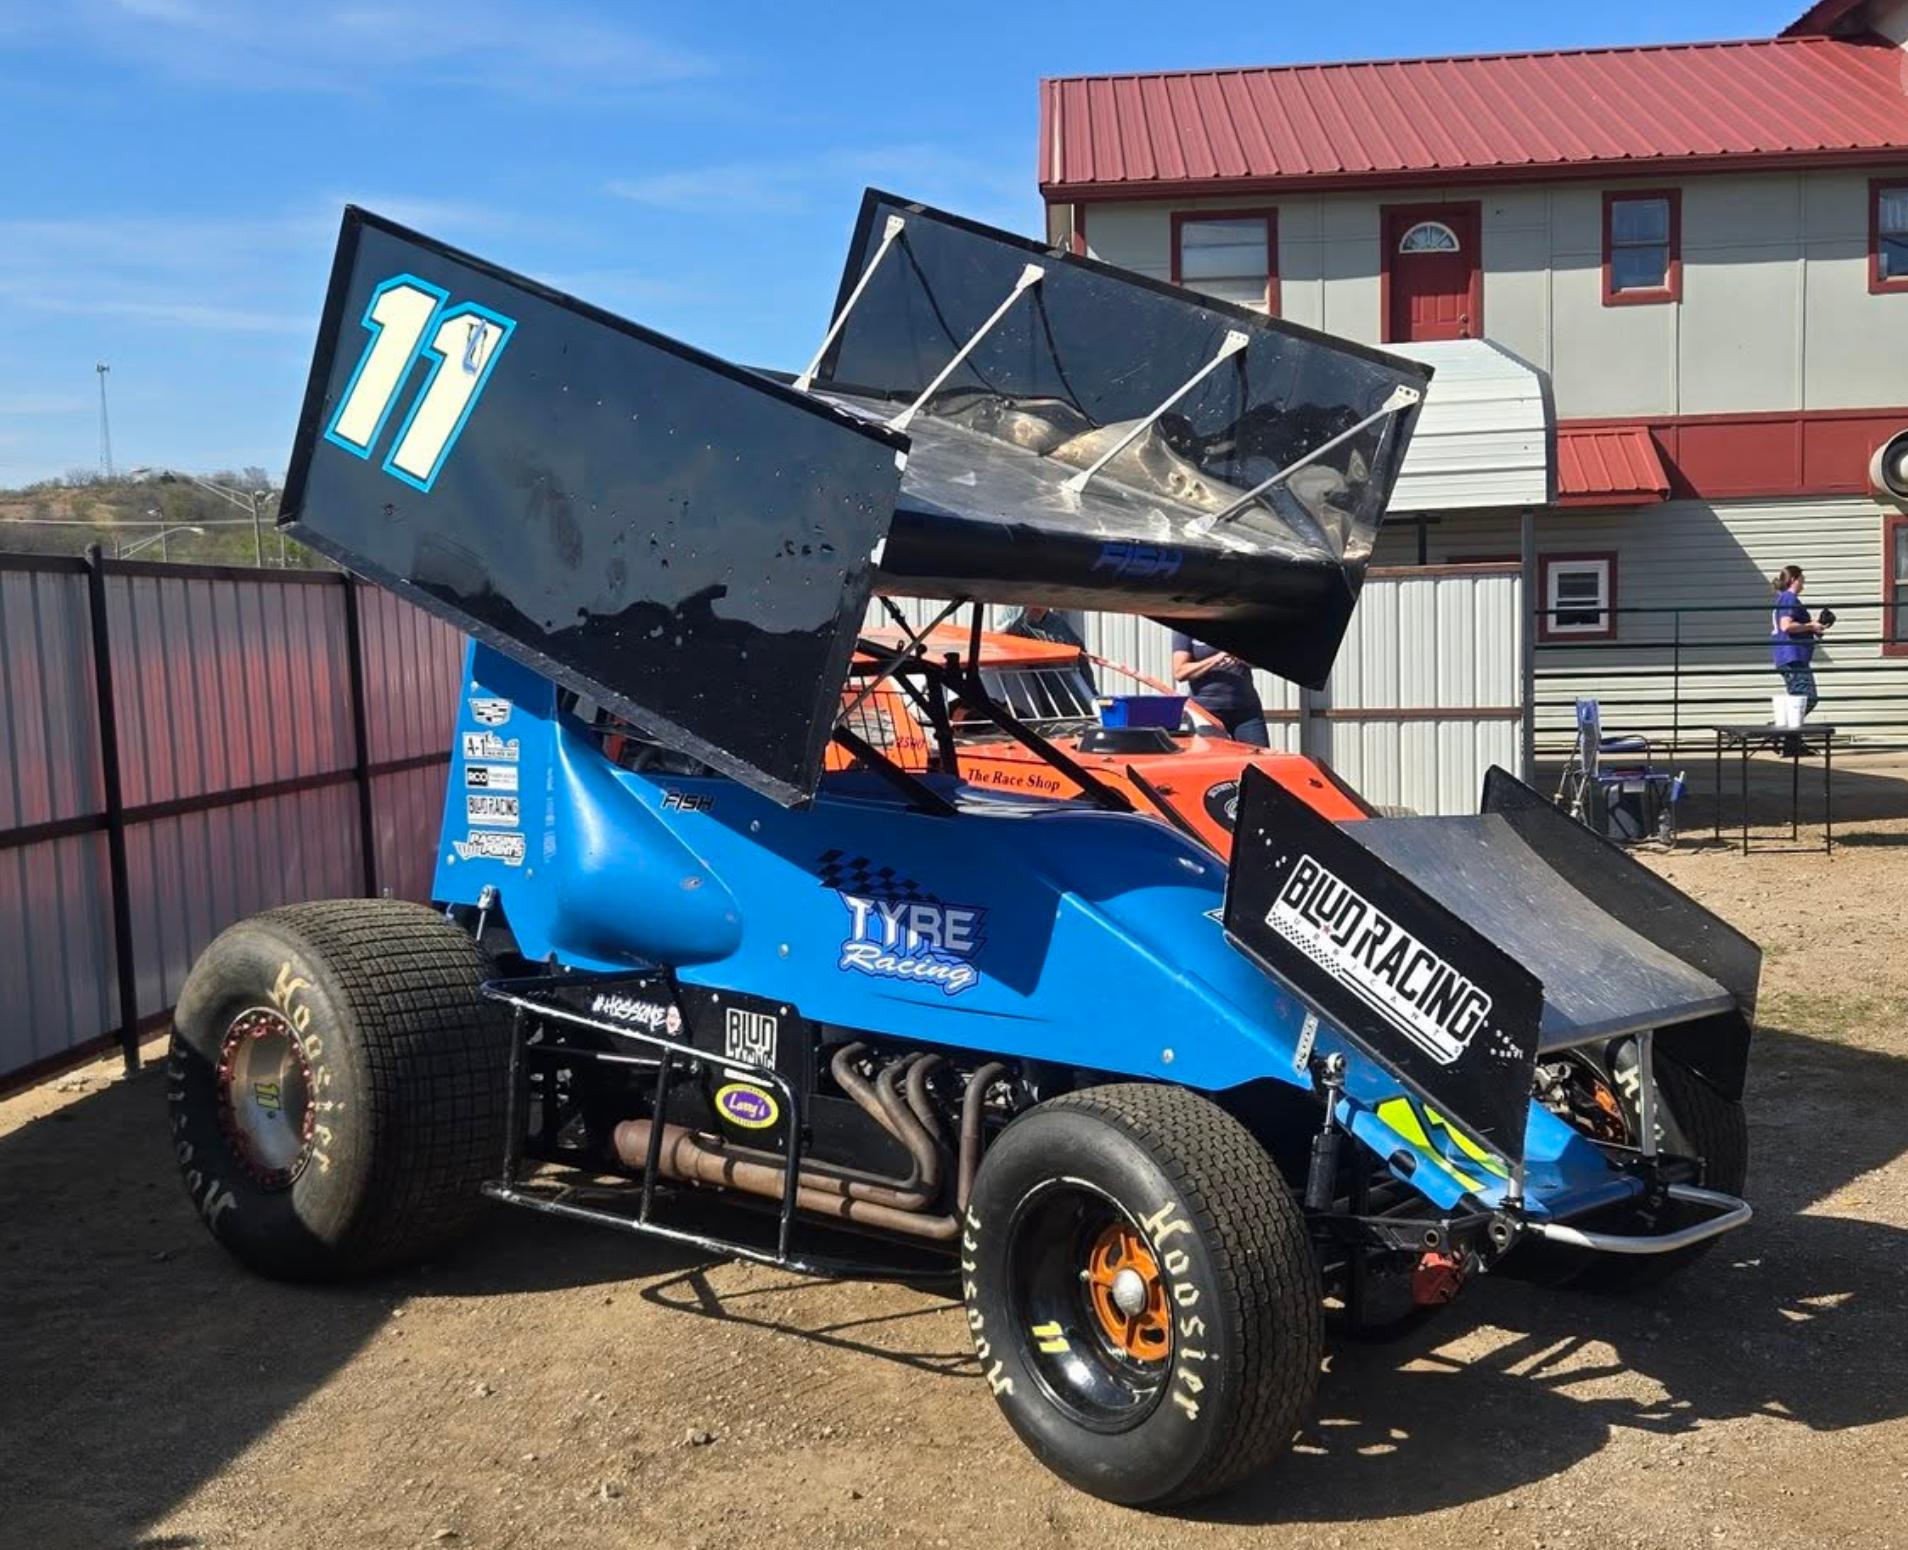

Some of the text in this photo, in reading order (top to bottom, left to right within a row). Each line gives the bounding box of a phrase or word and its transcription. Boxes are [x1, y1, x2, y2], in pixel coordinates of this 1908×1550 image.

[324, 273, 517, 493] 11
[1090, 543, 1183, 577] FISH
[968, 767, 1061, 793] The Race Shop
[662, 793, 716, 812] FISH
[846, 895, 977, 952] TYRE
[843, 943, 973, 990] Racing
[1281, 861, 1489, 1044] BLUD RACING
[1031, 1321, 1070, 1353] 11
